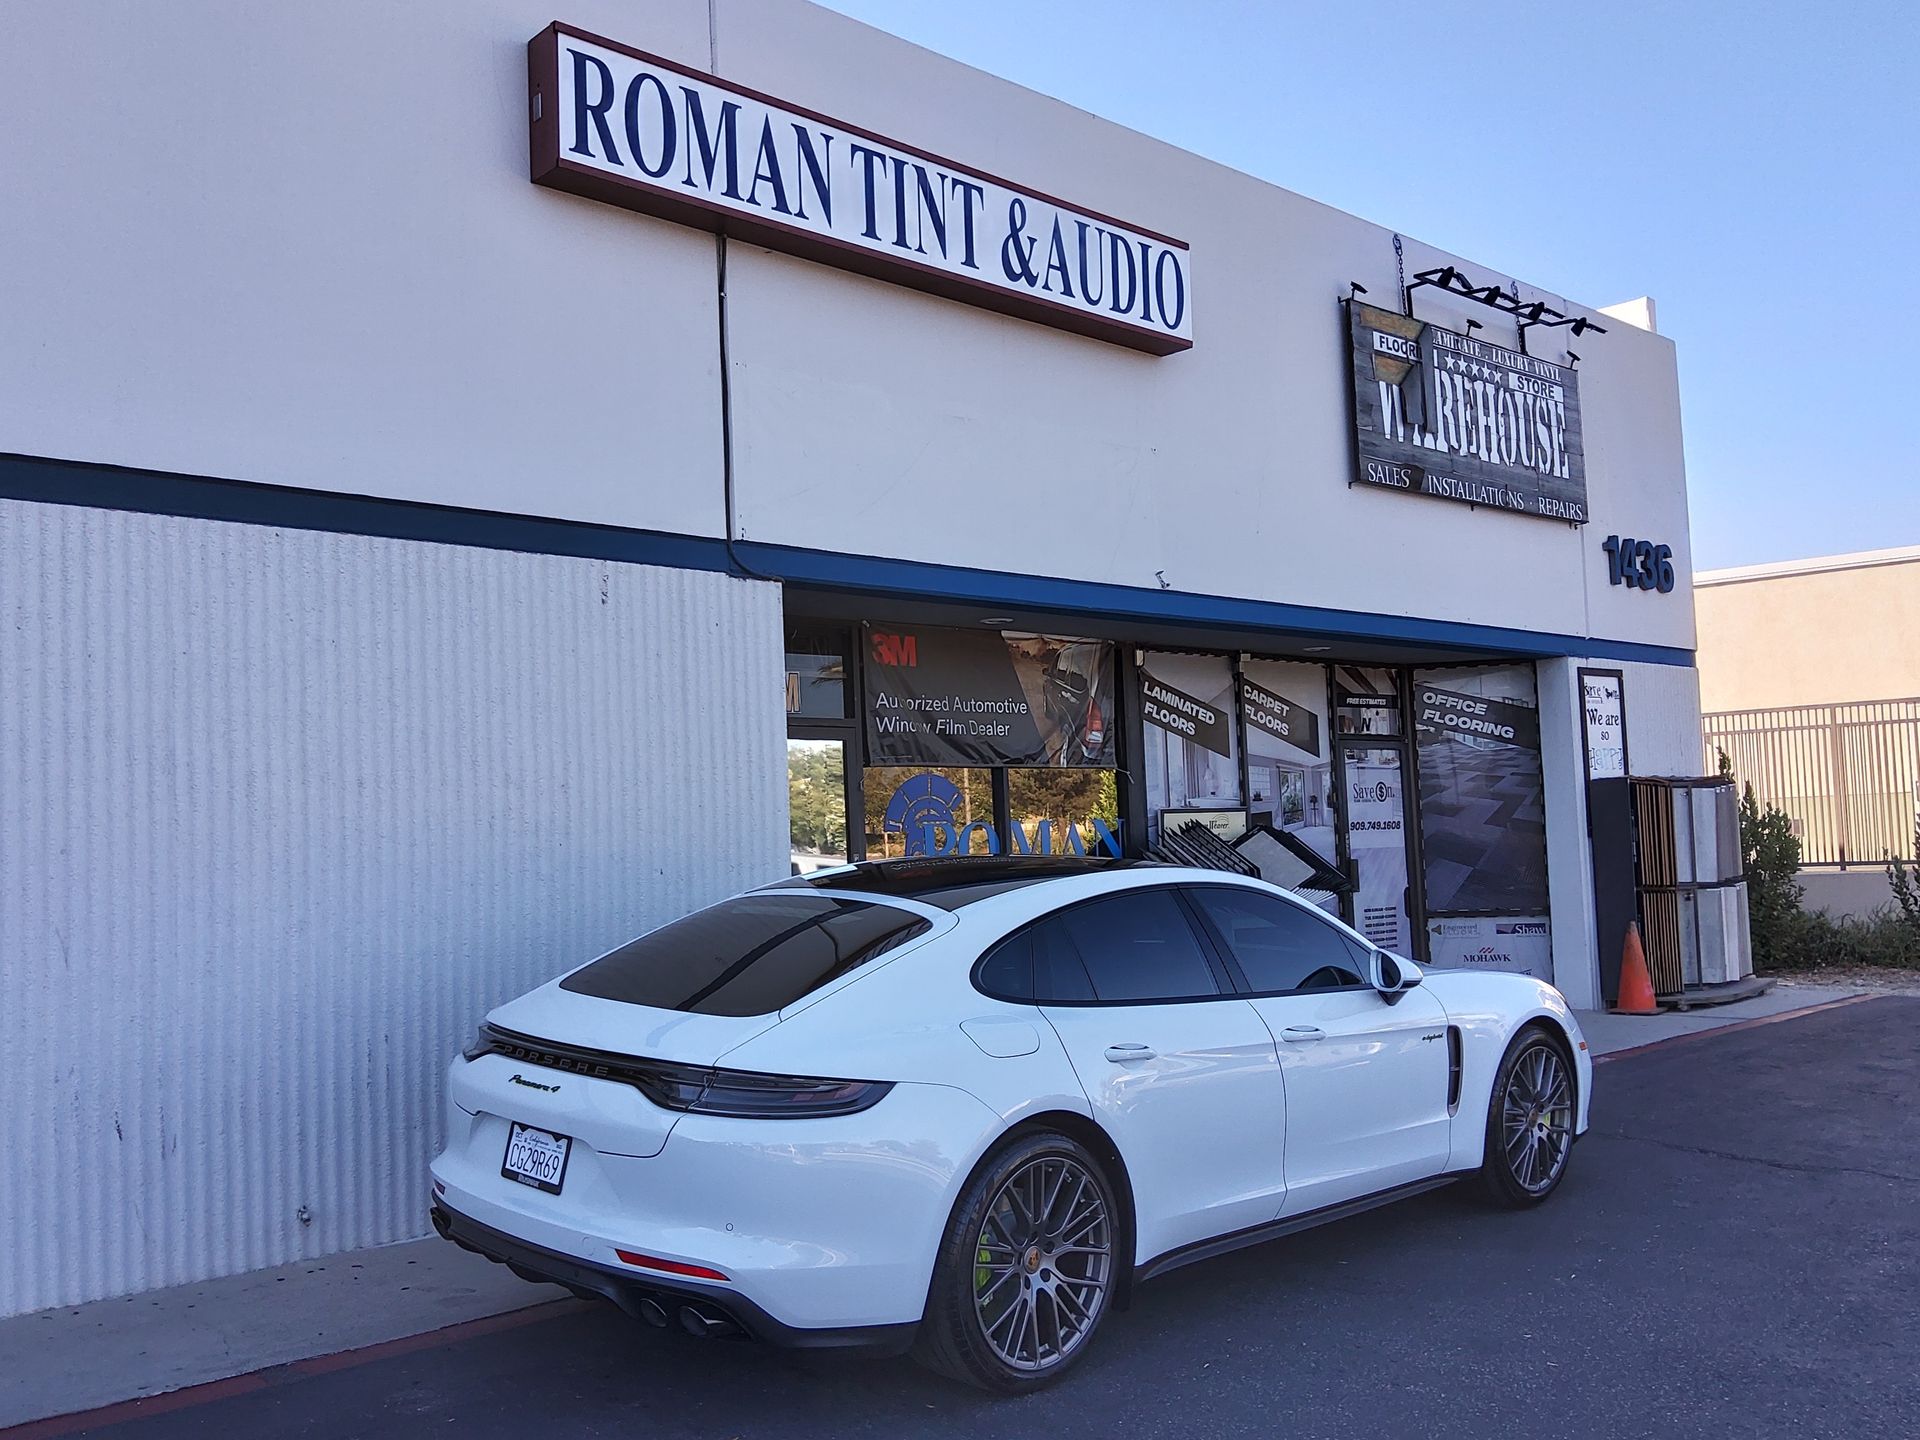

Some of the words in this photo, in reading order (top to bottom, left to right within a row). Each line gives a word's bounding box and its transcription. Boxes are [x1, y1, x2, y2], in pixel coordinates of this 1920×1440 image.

[565, 48, 834, 229] ROMAN
[850, 143, 984, 270] TINT
[1492, 348, 1530, 371] LUXURY
[1534, 361, 1560, 380] VINYL
[1517, 375, 1555, 399] STORE
[1379, 369, 1570, 479] WREHOUSE
[1367, 462, 1411, 488] SALES
[1427, 474, 1524, 510] INSTALLATIONS
[1538, 496, 1583, 521] REPAIRS
[1602, 534, 1675, 594] 1436
[871, 632, 918, 667] 3M
[953, 696, 1028, 714] Automotive
[1143, 681, 1215, 726] LAMINATED
[1243, 684, 1290, 717] CARPET
[1346, 697, 1359, 705] FREE
[1422, 691, 1488, 716] OFFICE
[936, 719, 967, 735] Film
[969, 719, 1010, 736] Dealer
[1144, 701, 1196, 736] FLOORS
[1244, 704, 1290, 737] FLOORS
[1422, 709, 1515, 740] FLOORING
[1587, 708, 1603, 726] We
[1605, 714, 1619, 726] are
[1349, 820, 1401, 831] 909.749.1608
[1515, 924, 1546, 935] Shaw
[1463, 953, 1512, 963] MOHAWK
[503, 1044, 609, 1077] PORSCHE
[510, 1142, 560, 1180] CG29R69
